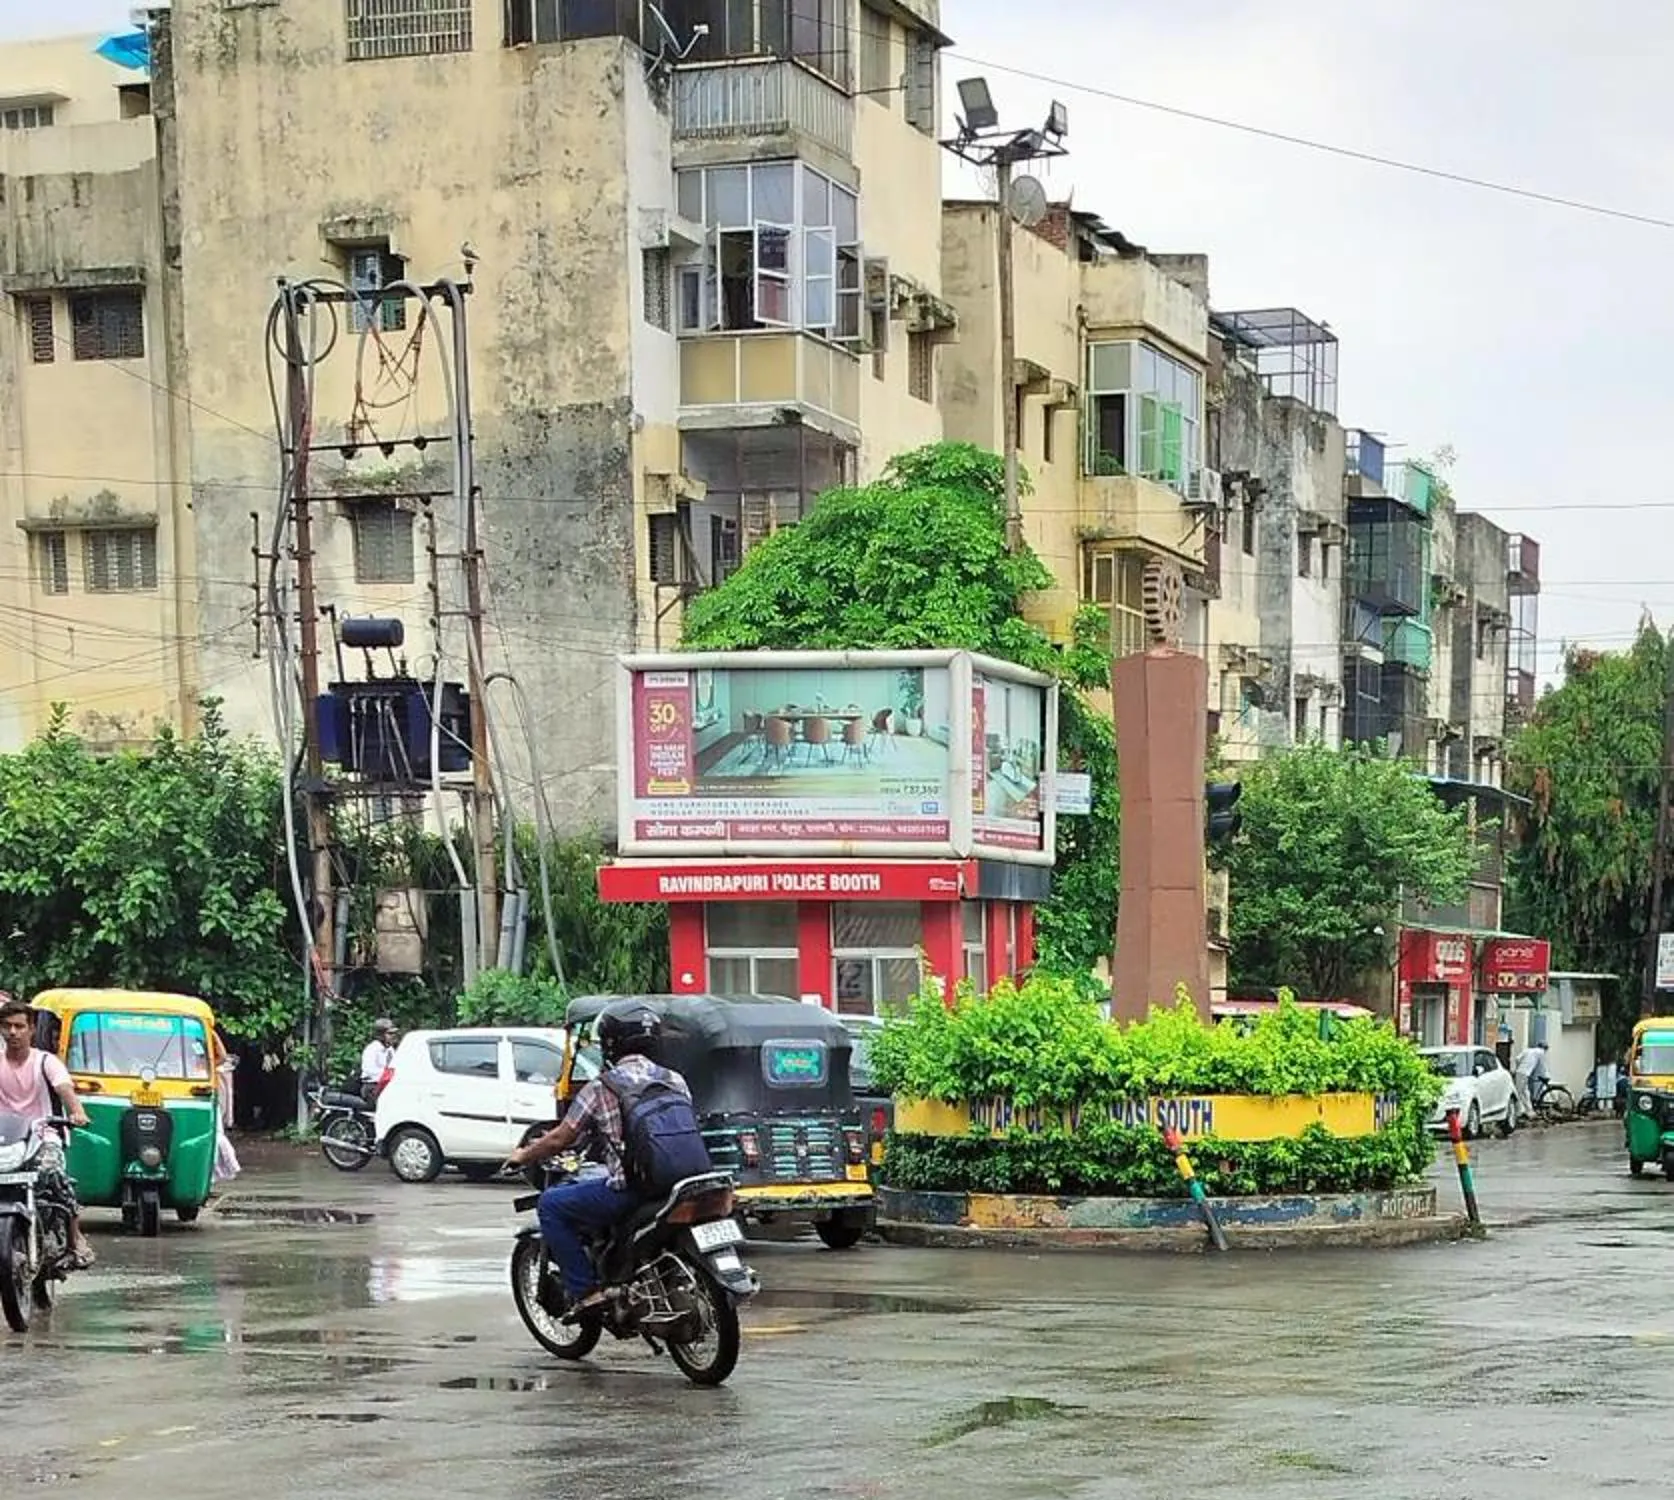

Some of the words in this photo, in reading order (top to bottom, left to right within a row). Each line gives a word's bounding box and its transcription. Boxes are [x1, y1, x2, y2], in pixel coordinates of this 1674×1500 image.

[659, 873, 769, 893] RAVINDRAPURI
[829, 873, 881, 891] BOOTH
[1156, 1098, 1213, 1136] SOUTH
